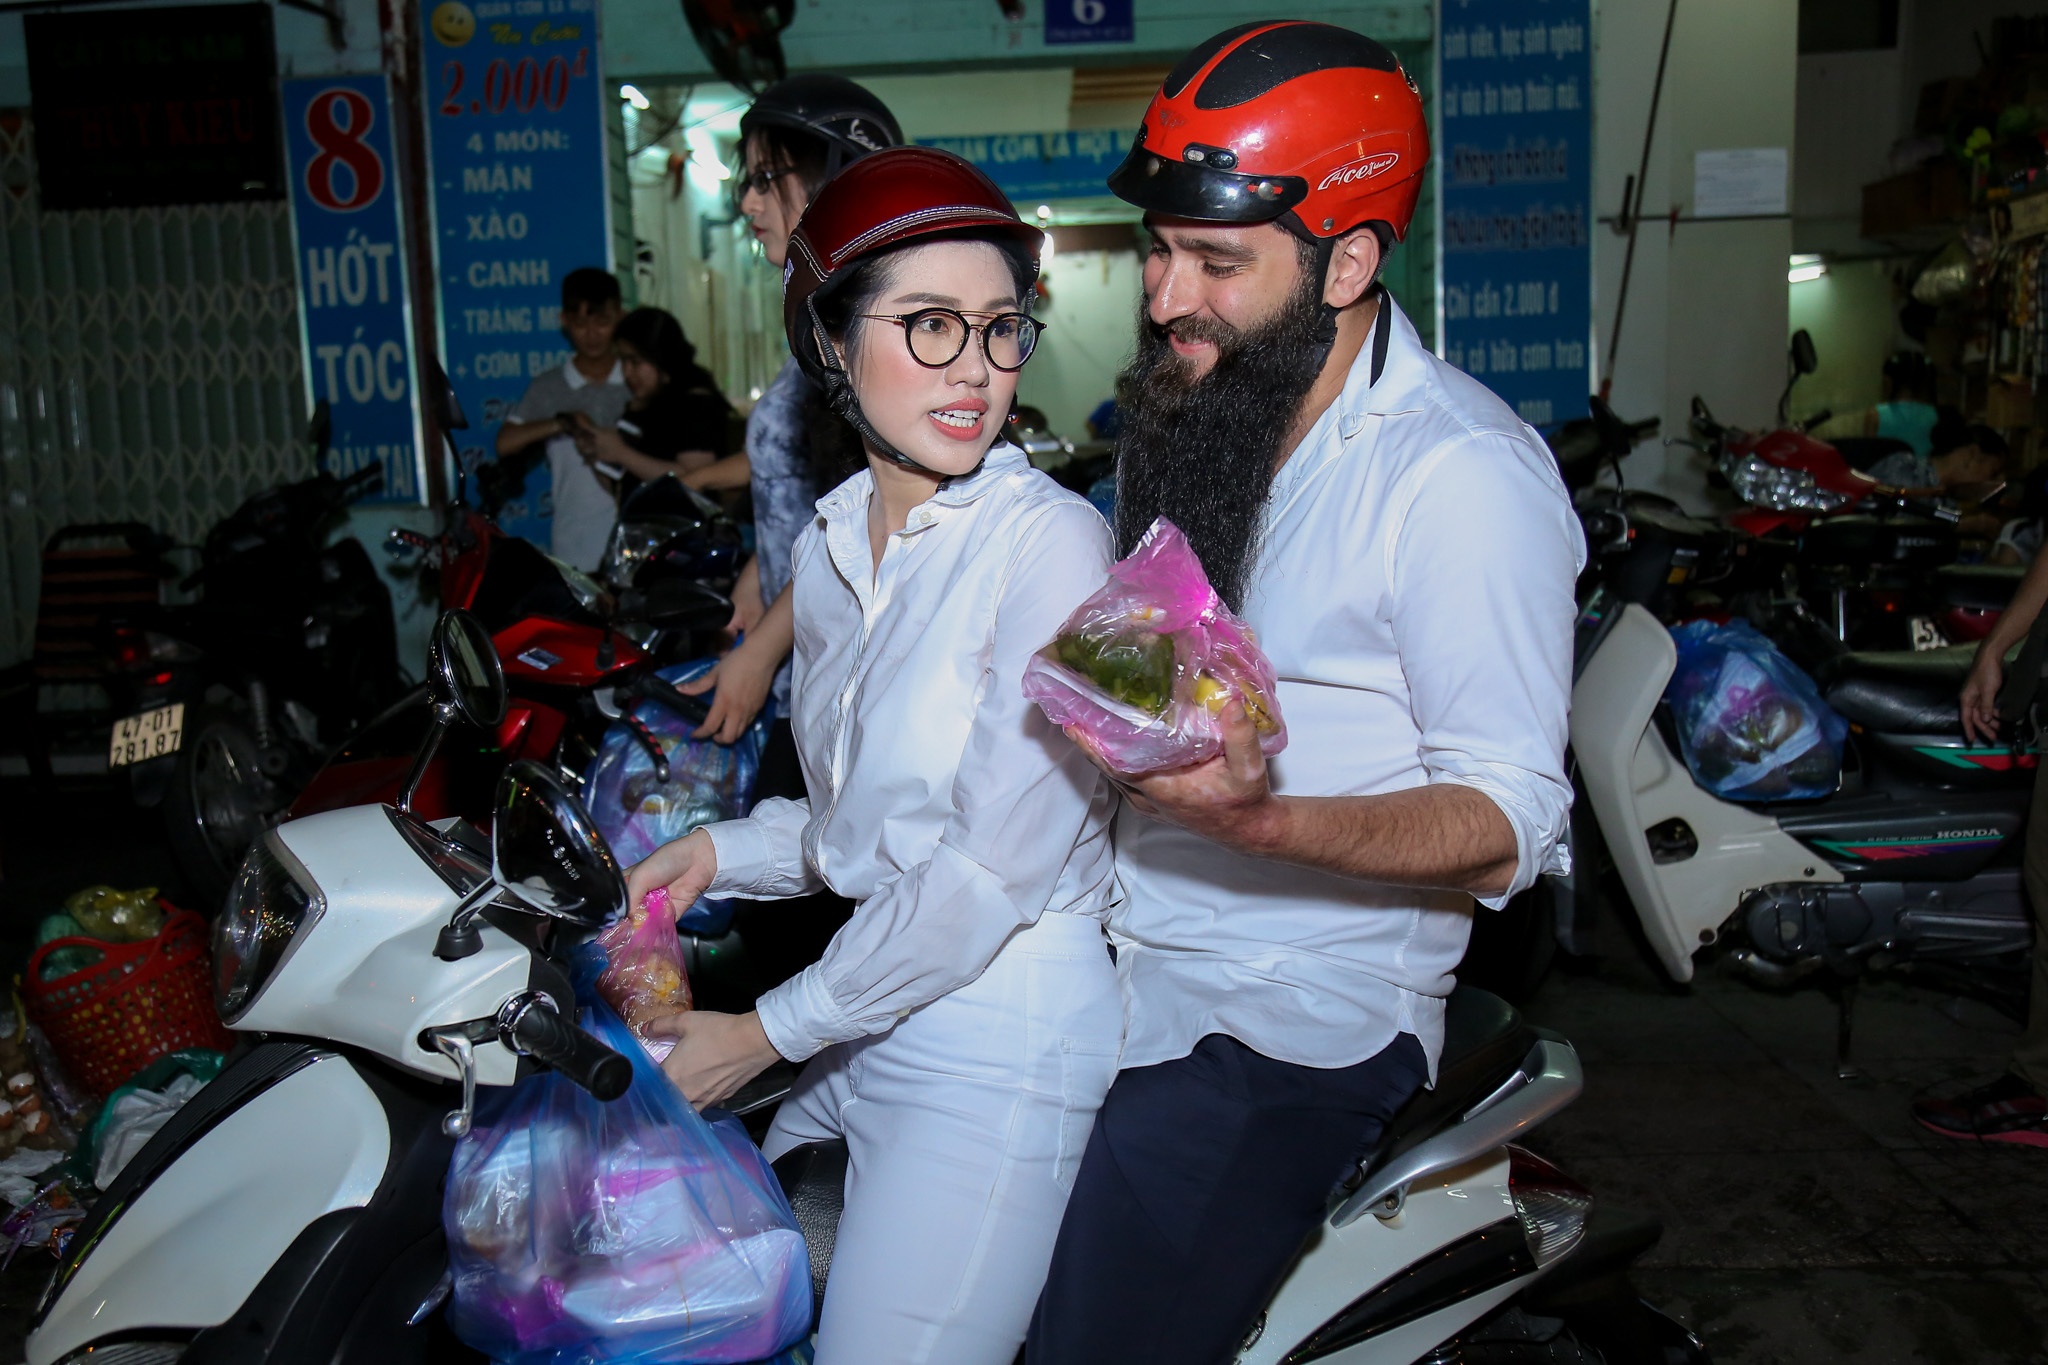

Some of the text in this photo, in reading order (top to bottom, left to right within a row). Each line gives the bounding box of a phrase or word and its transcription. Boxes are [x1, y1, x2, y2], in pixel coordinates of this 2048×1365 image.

[304, 86, 385, 214] 8
[466, 131, 483, 154] 4
[467, 259, 551, 288] CANH
[1503, 280, 1546, 317] 2.000
[316, 325, 406, 405] TÓC
[1936, 828, 2001, 840] HONDA
